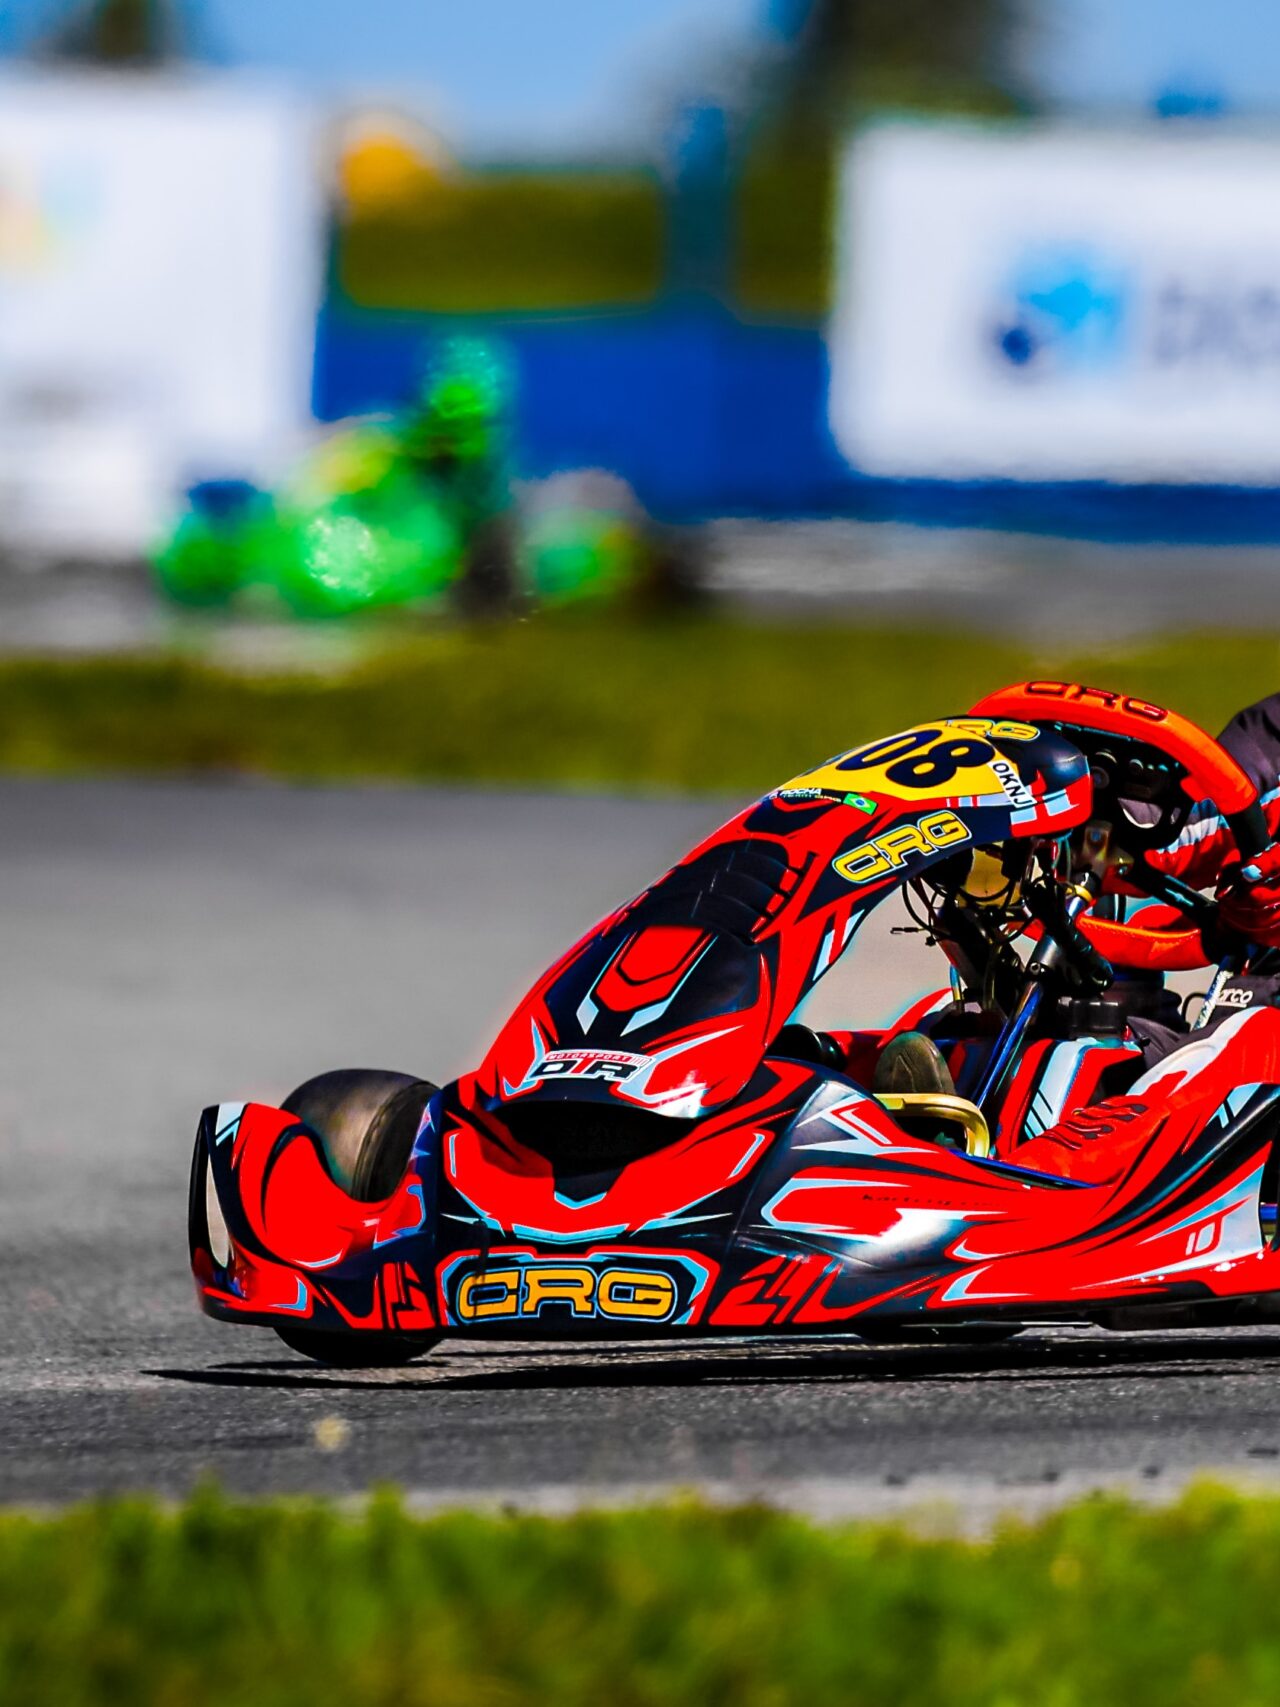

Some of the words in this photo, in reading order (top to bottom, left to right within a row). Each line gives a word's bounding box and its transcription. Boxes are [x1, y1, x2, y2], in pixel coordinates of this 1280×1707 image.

[1024, 681, 1169, 722] CRG
[946, 718, 1040, 741] RG
[835, 728, 996, 789] 08
[992, 761, 1034, 806] OKNJ
[831, 809, 973, 884] CRG
[529, 1057, 639, 1079] DTR
[547, 1052, 630, 1062] MOTORSPORT
[456, 1265, 678, 1323] CRG
